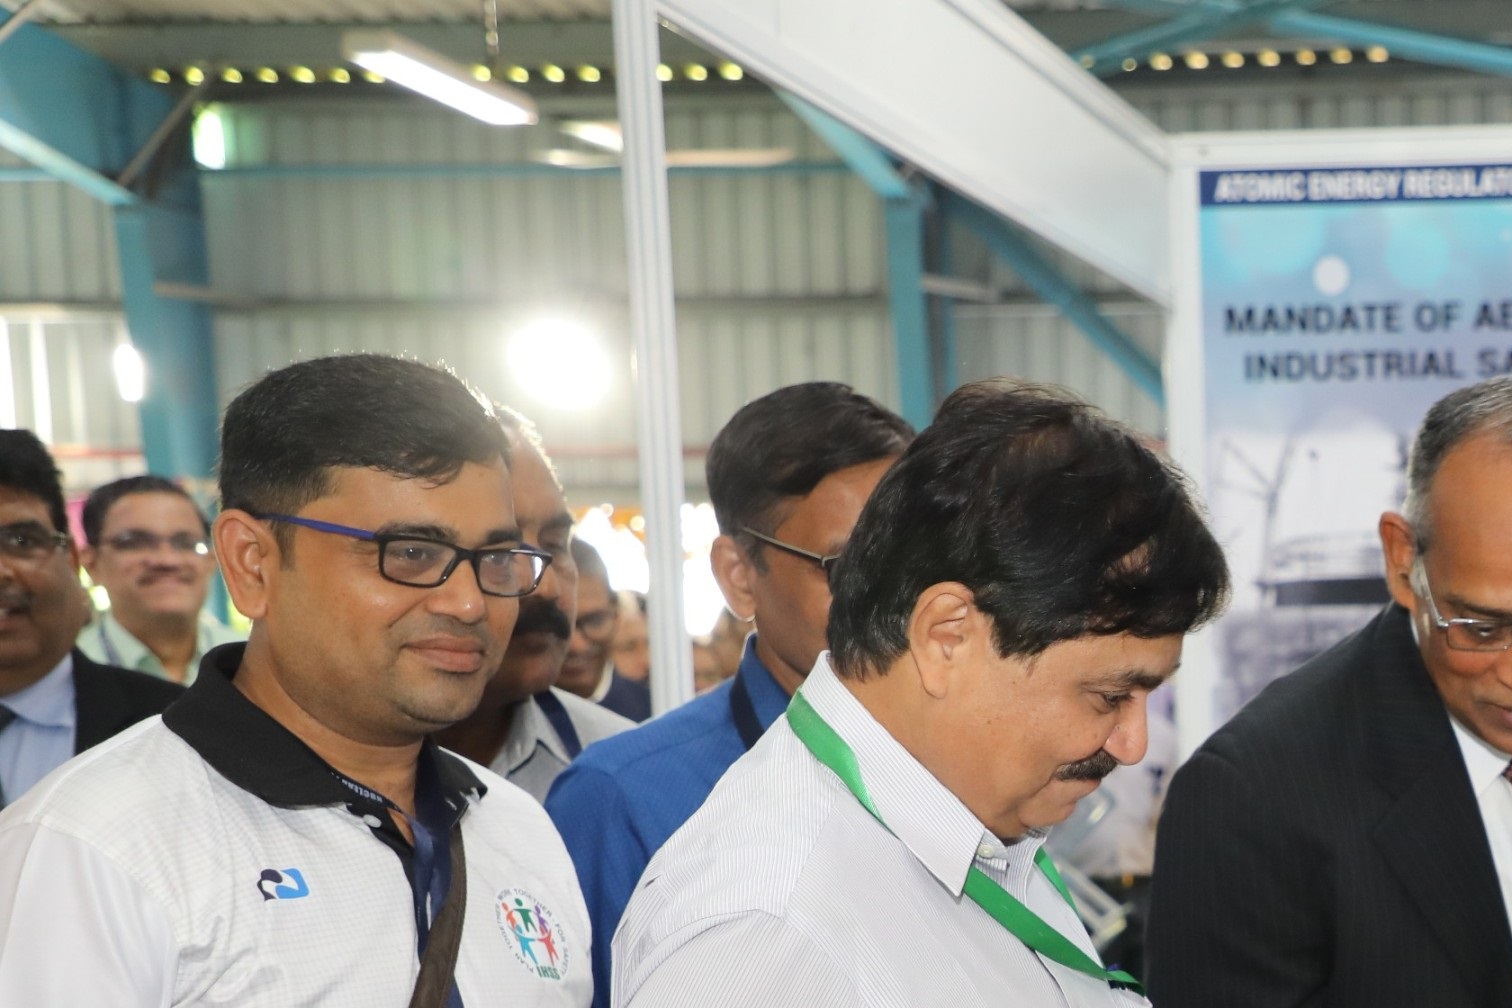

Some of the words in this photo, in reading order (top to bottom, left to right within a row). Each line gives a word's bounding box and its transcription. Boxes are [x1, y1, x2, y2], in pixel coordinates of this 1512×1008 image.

[1214, 171, 1305, 202] ATOMIC
[1308, 168, 1402, 200] ENERGY
[1224, 301, 1404, 335] MANDATE
[1414, 300, 1461, 333] OF
[1244, 347, 1464, 382] INDUSTRIAL
